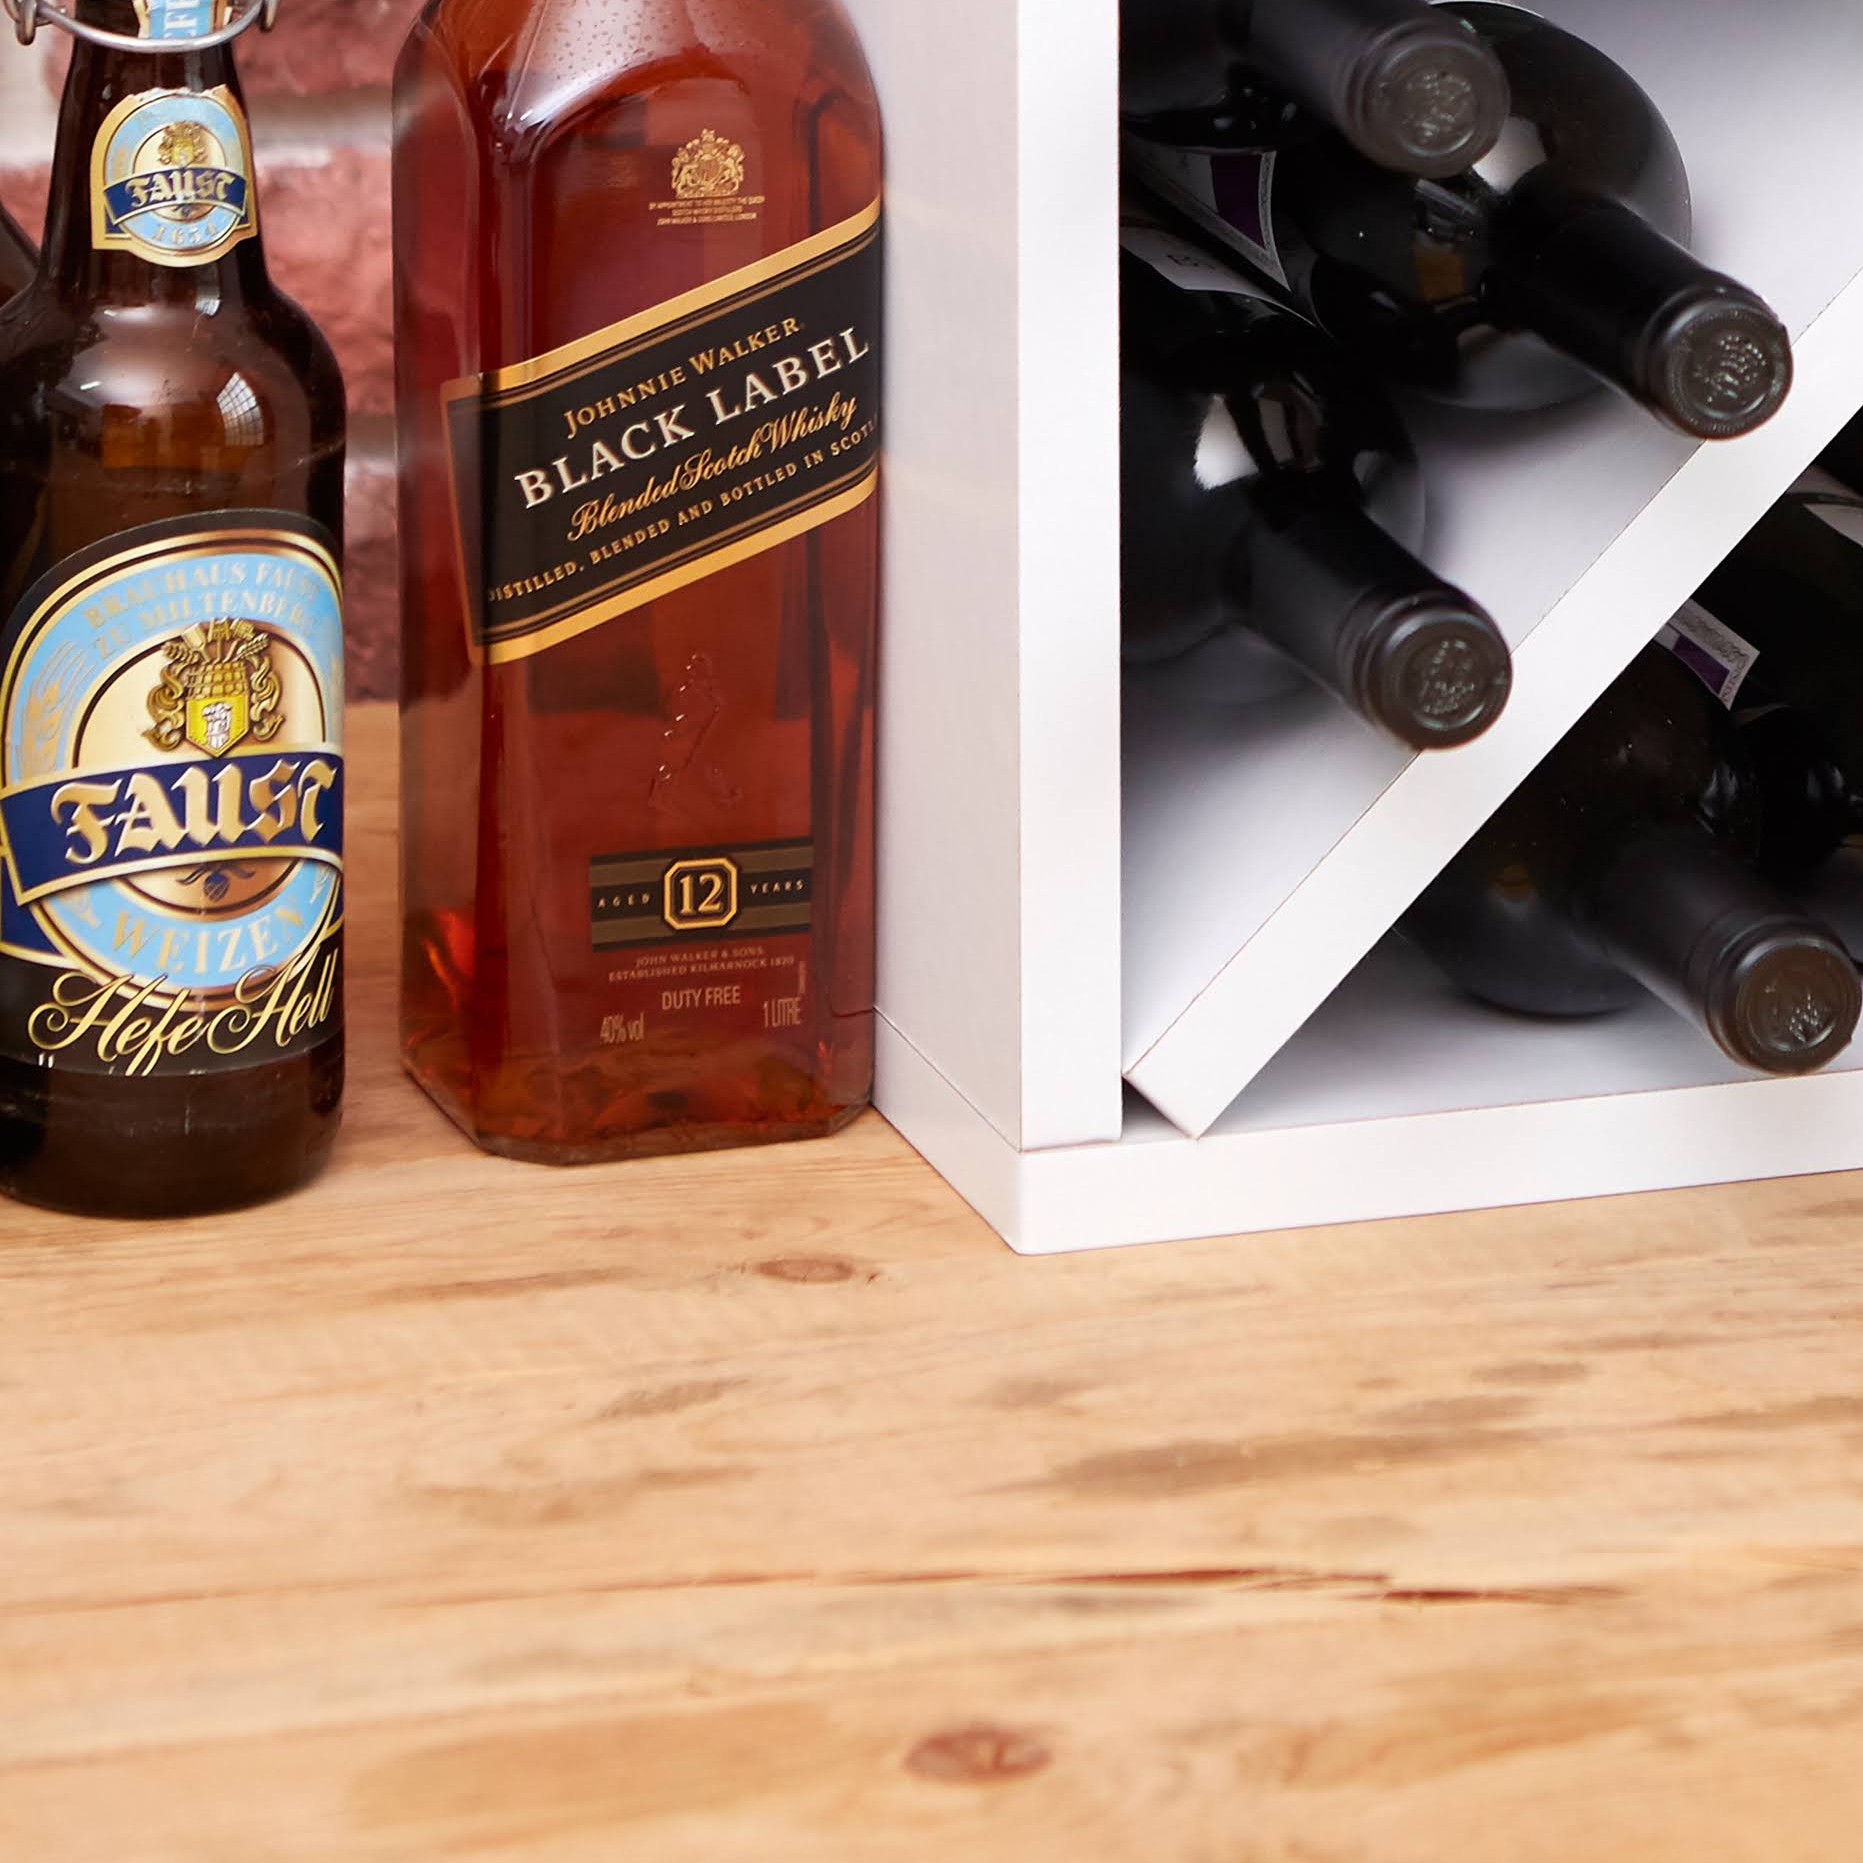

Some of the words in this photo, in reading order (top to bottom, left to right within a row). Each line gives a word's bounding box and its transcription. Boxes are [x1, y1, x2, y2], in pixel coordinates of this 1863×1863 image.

[125, 170, 235, 208] FAUST
[514, 404, 695, 509] BLACK
[705, 327, 870, 425] LABEL
[563, 366, 687, 439] JOHNNIE
[689, 317, 801, 374] WALKER
[566, 465, 680, 542] Blended
[679, 427, 763, 491] Scotch
[760, 391, 857, 454] Whisky
[589, 518, 671, 565] BLENDED
[677, 499, 713, 526] AND
[719, 462, 798, 507] BOTTLED
[803, 449, 824, 470] IN
[51, 758, 337, 865] FAUST
[111, 898, 305, 975] WEIZEN
[597, 893, 650, 909] AGED
[680, 874, 723, 915] 12
[751, 879, 804, 895] YEARS
[636, 954, 667, 968] JOHN
[661, 989, 702, 1011] DUTY
[705, 985, 741, 1006] FREE
[28, 974, 209, 1077] Hefe
[207, 945, 339, 1055] Hell
[772, 996, 802, 1028] LITRE
